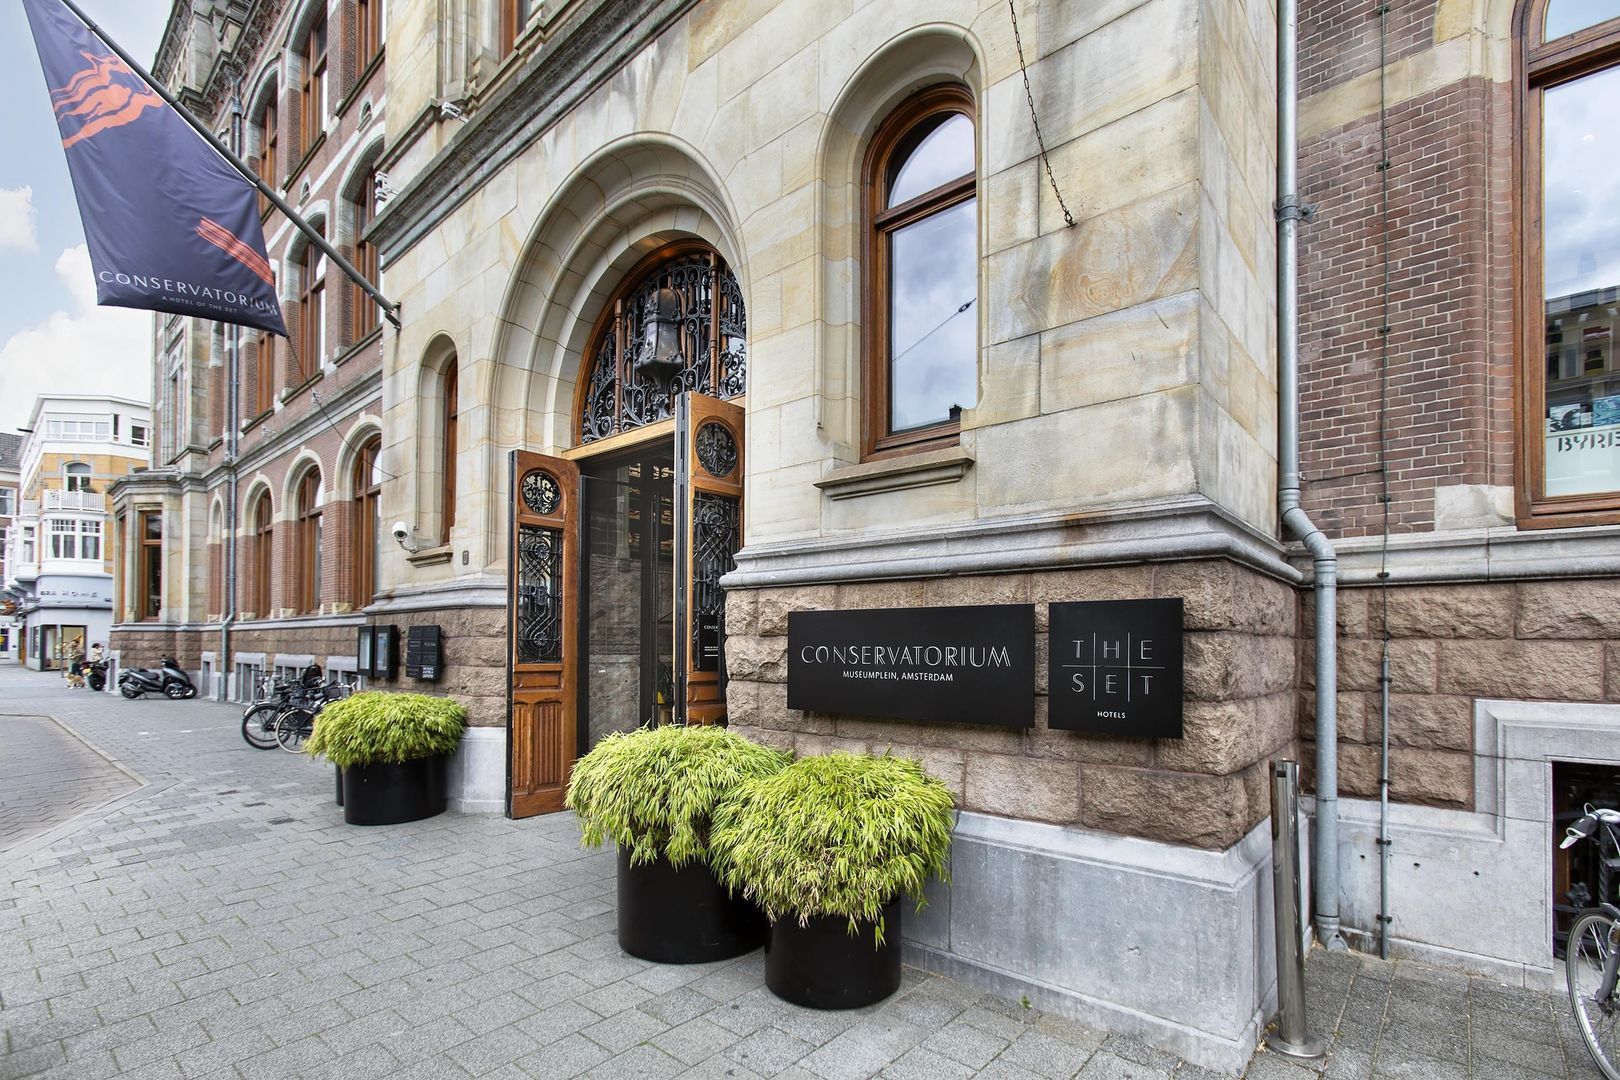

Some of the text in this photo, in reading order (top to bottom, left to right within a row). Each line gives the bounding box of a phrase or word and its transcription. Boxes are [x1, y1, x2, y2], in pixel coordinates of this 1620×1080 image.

[99, 271, 278, 315] CONSERVATORIUM
[170, 297, 194, 305] HOTEL
[801, 645, 1011, 668] CONSERVATORIUM
[1072, 640, 1153, 660] THE
[842, 670, 954, 682] MUSEUMPLEIN, AMSTERDAM
[1072, 673, 1153, 695] SET
[1097, 711, 1126, 719] HOTELS
